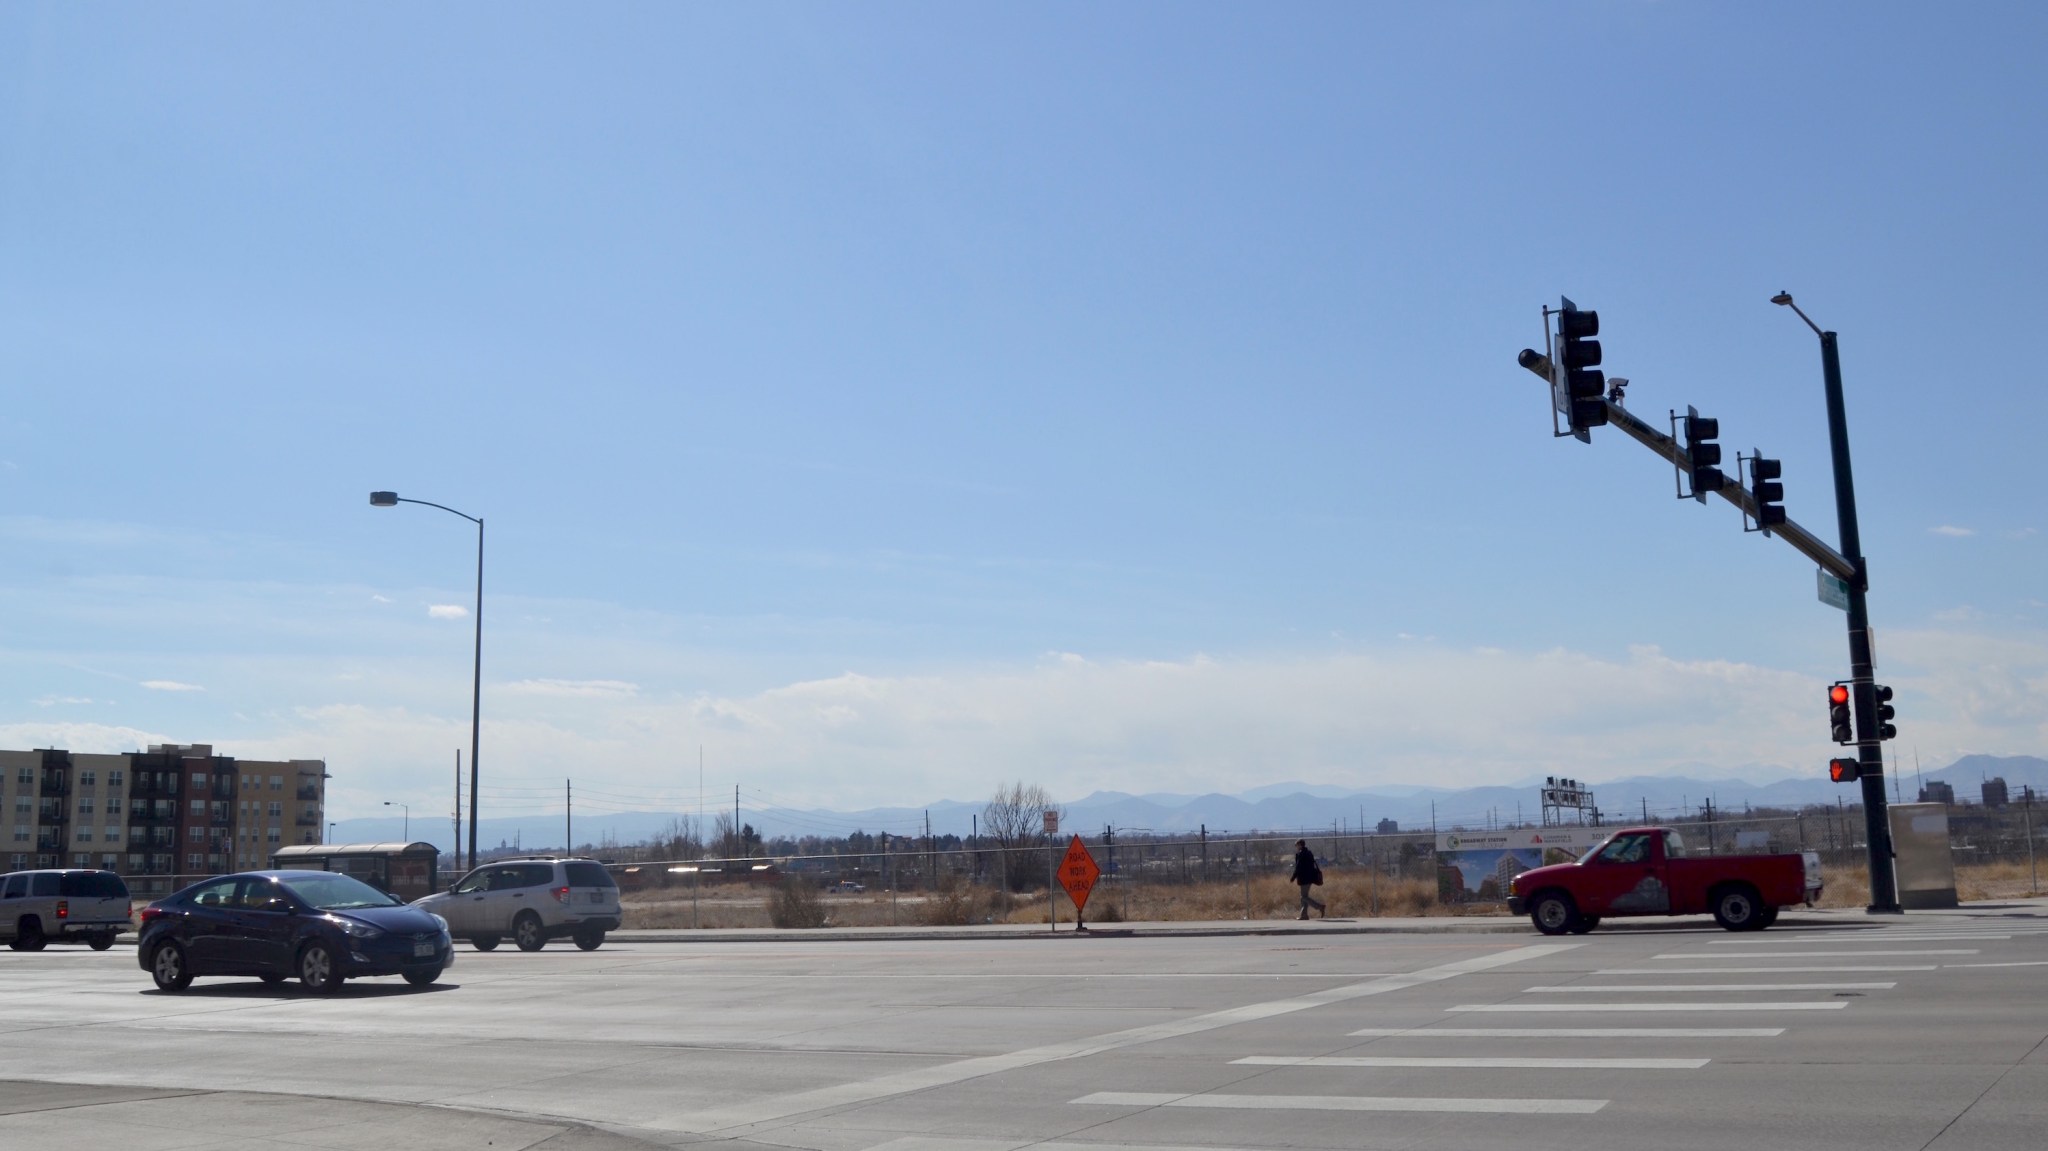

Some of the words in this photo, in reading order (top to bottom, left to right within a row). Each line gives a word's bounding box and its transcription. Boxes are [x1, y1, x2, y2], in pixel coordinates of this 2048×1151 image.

[1069, 852, 1085, 862] ROAD
[1069, 866, 1086, 876] WORK
[1069, 880, 1088, 891] AHEAD
